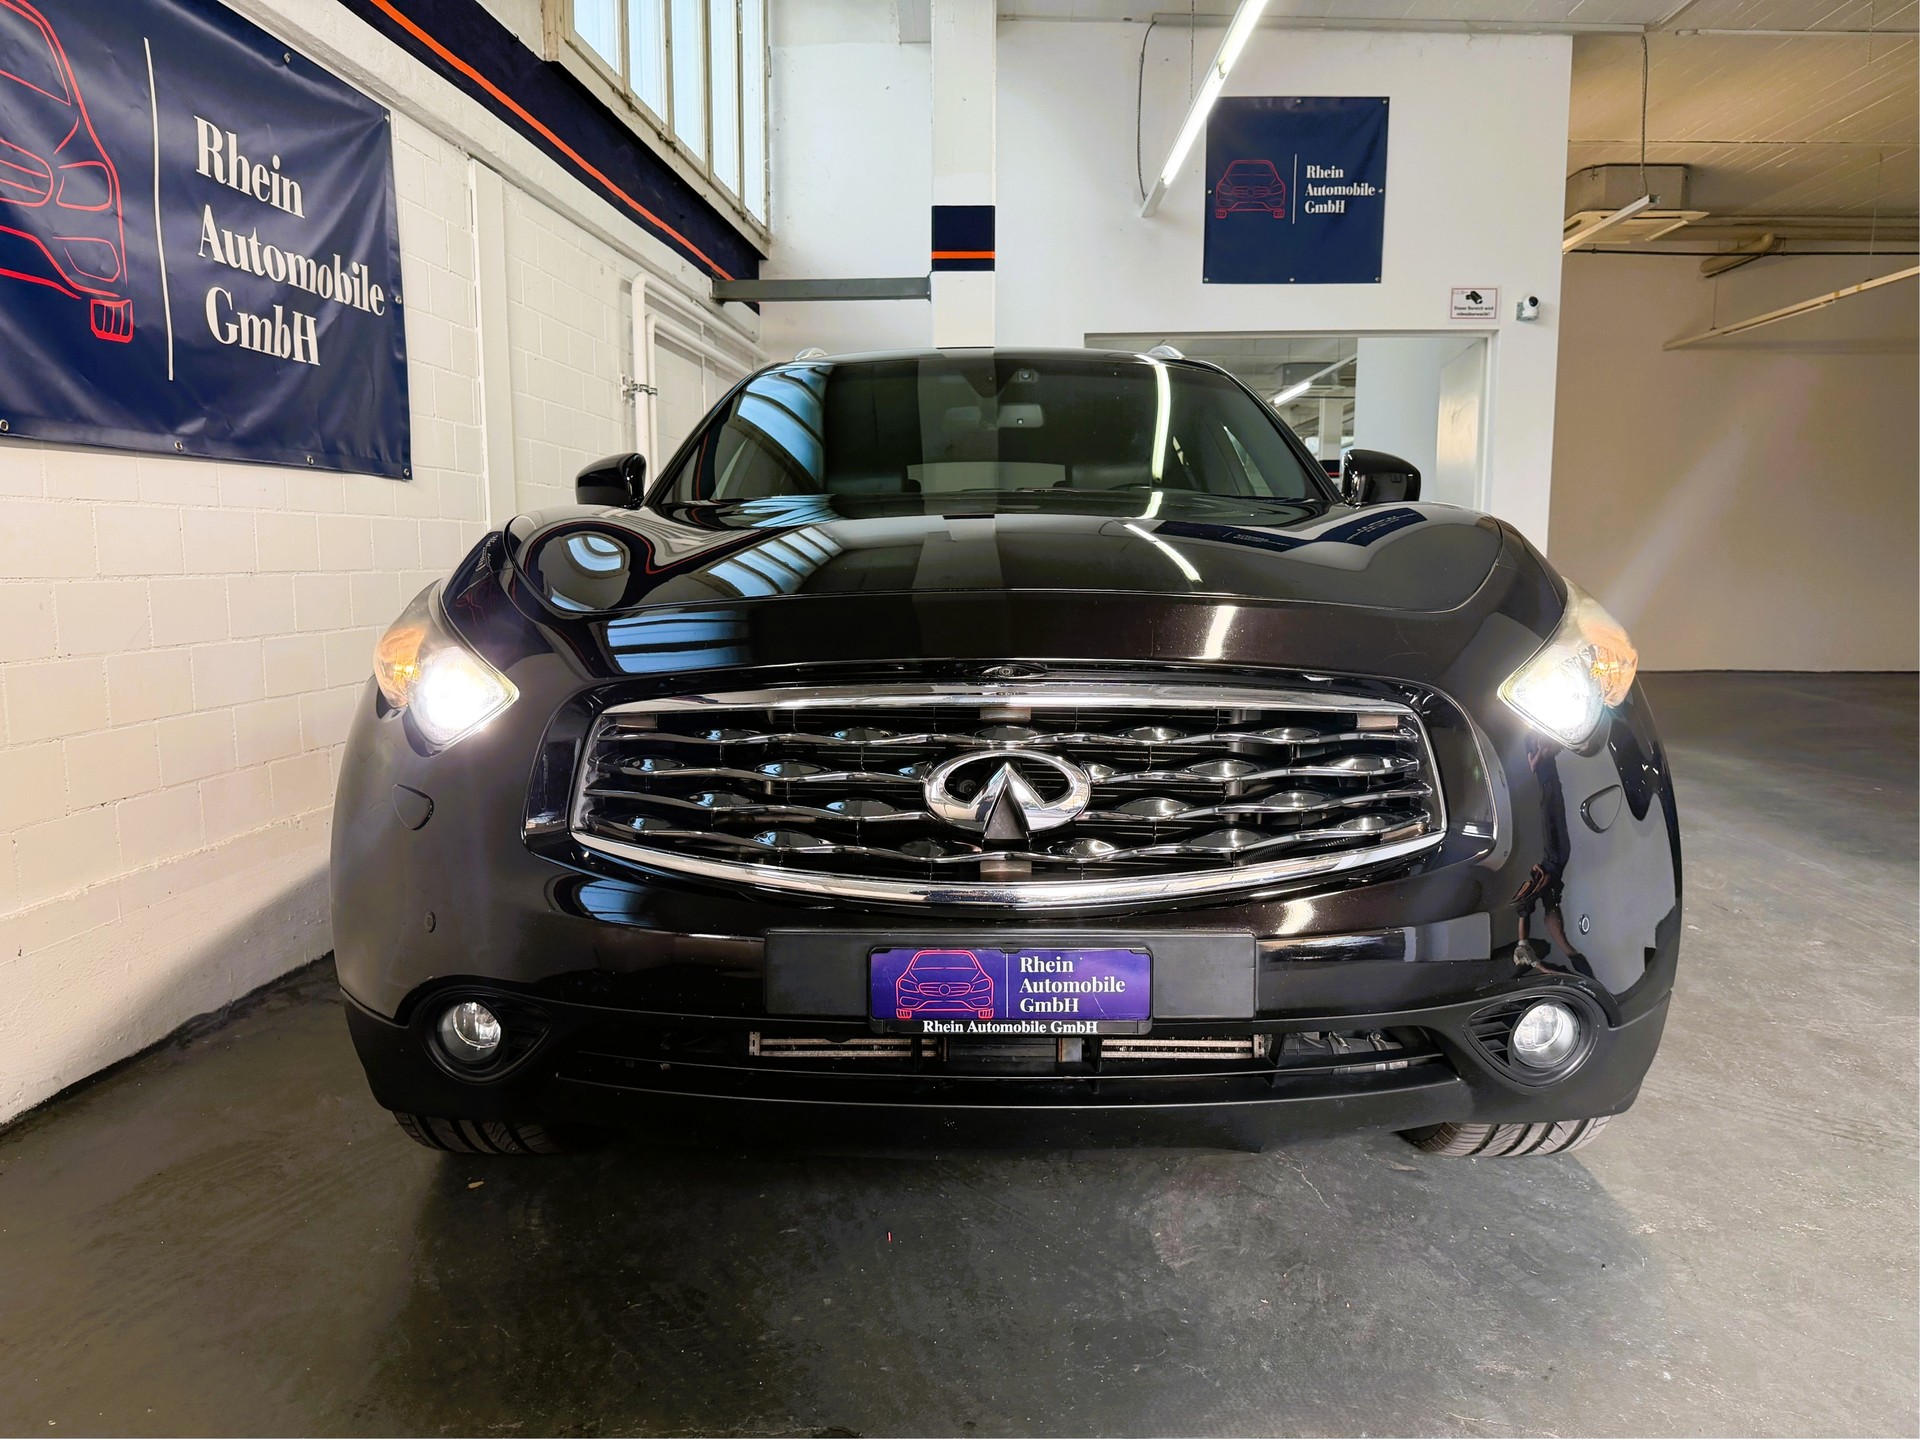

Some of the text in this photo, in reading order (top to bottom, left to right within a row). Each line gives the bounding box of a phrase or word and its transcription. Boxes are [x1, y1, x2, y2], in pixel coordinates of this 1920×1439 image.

[194, 115, 305, 219] Rhein
[1306, 165, 1344, 179] Rhein
[1305, 183, 1376, 197] Automobile
[1304, 200, 1346, 214] GmbH
[198, 204, 385, 316] Automobile
[205, 286, 321, 366] GmbH
[1020, 956, 1074, 973] Rhein
[1019, 976, 1126, 993] Automobile
[1020, 997, 1079, 1013] GmbH
[922, 1020, 1099, 1034] Rhein Automobile GmbH
